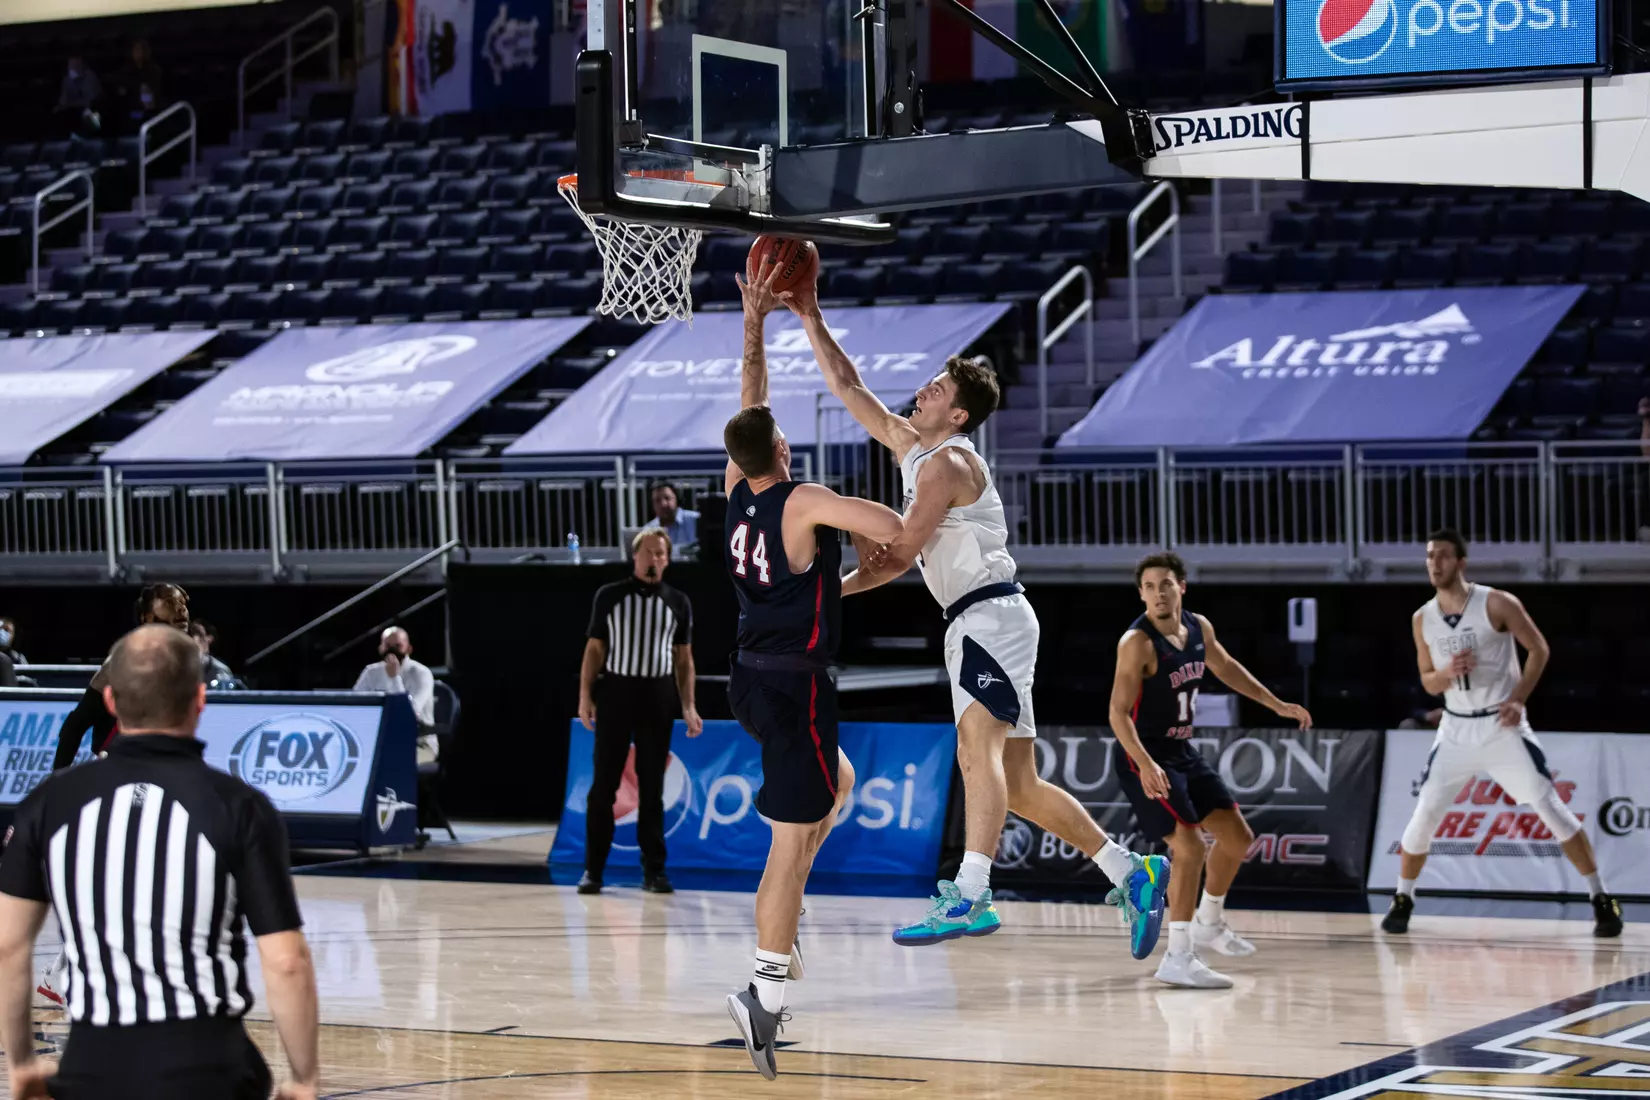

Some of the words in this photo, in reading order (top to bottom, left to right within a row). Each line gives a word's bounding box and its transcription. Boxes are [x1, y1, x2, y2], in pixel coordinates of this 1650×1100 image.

[1408, 0, 1570, 47] pepsi
[1154, 104, 1302, 151] SPALDING
[1190, 334, 1449, 368] Altura
[730, 520, 771, 586] 44
[1177, 687, 1199, 721] 1
[255, 730, 334, 769] FOX
[251, 769, 328, 786] SPORTS
[699, 763, 917, 840] psi
